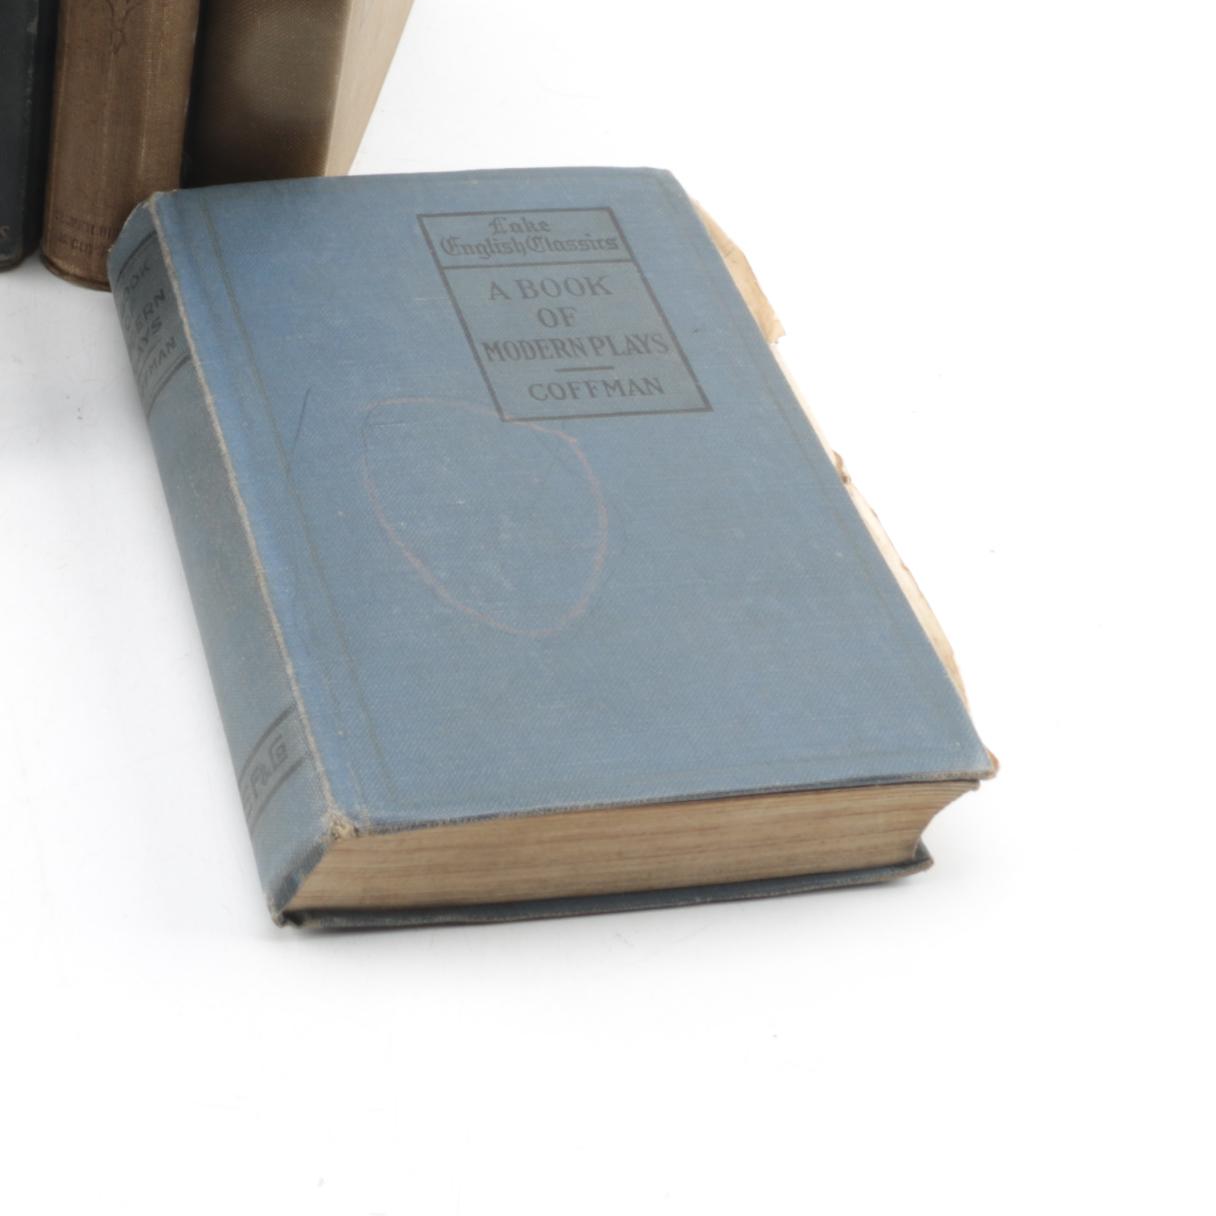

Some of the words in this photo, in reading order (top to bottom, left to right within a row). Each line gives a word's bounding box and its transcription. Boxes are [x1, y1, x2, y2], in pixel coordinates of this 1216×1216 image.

[488, 280, 511, 300] A
[515, 275, 613, 299] BOOK
[537, 306, 577, 328] OF
[480, 336, 586, 362] MODERN
[590, 333, 669, 357] PLAYS
[528, 378, 665, 401] COFFMAN
